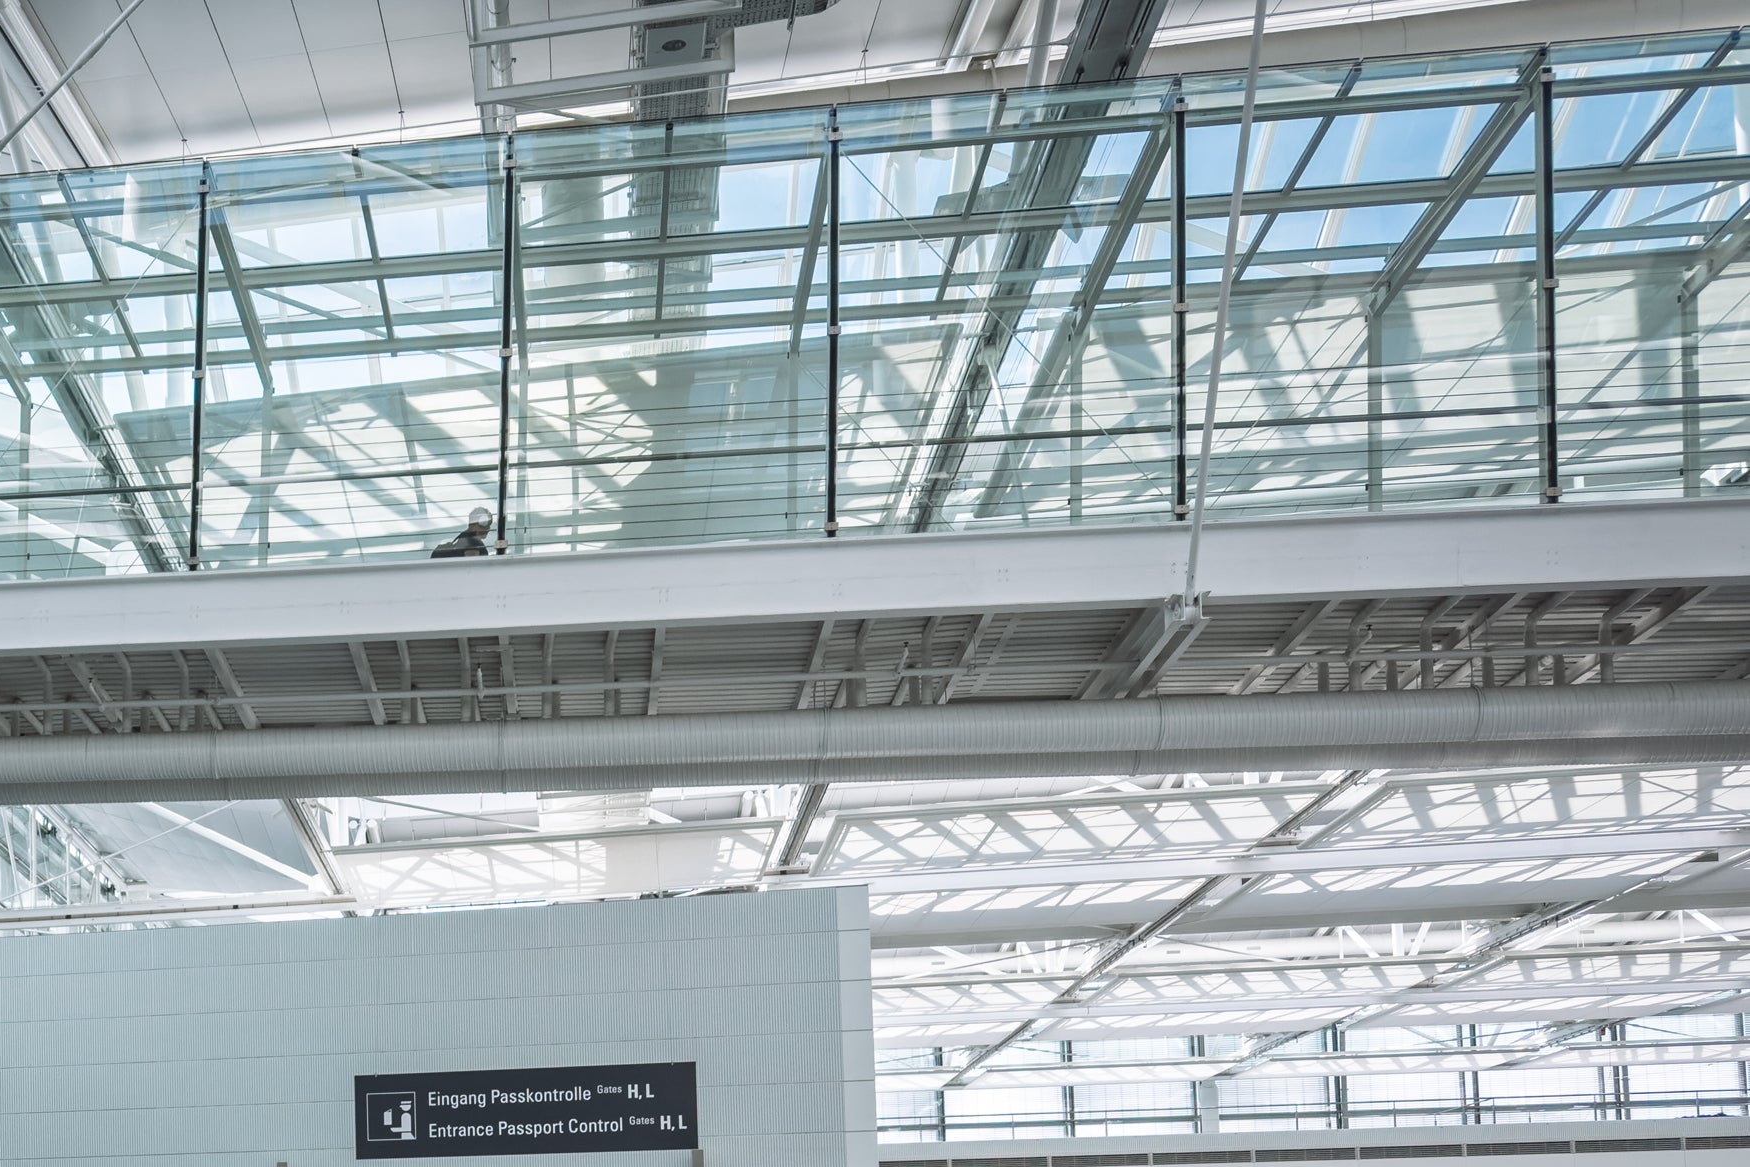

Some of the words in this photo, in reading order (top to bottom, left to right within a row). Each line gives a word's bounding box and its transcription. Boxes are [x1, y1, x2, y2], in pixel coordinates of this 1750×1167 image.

[428, 1091, 486, 1109] Eingang
[491, 1086, 591, 1104] Passkontrolle
[597, 1084, 622, 1094] Gates
[627, 1084, 642, 1100] H,
[645, 1083, 655, 1098] L
[429, 1122, 494, 1138] Entrance
[498, 1120, 564, 1138] Passport
[568, 1116, 623, 1134] Control
[629, 1115, 655, 1125] Gates
[660, 1115, 675, 1131] H,
[678, 1114, 688, 1129] L
